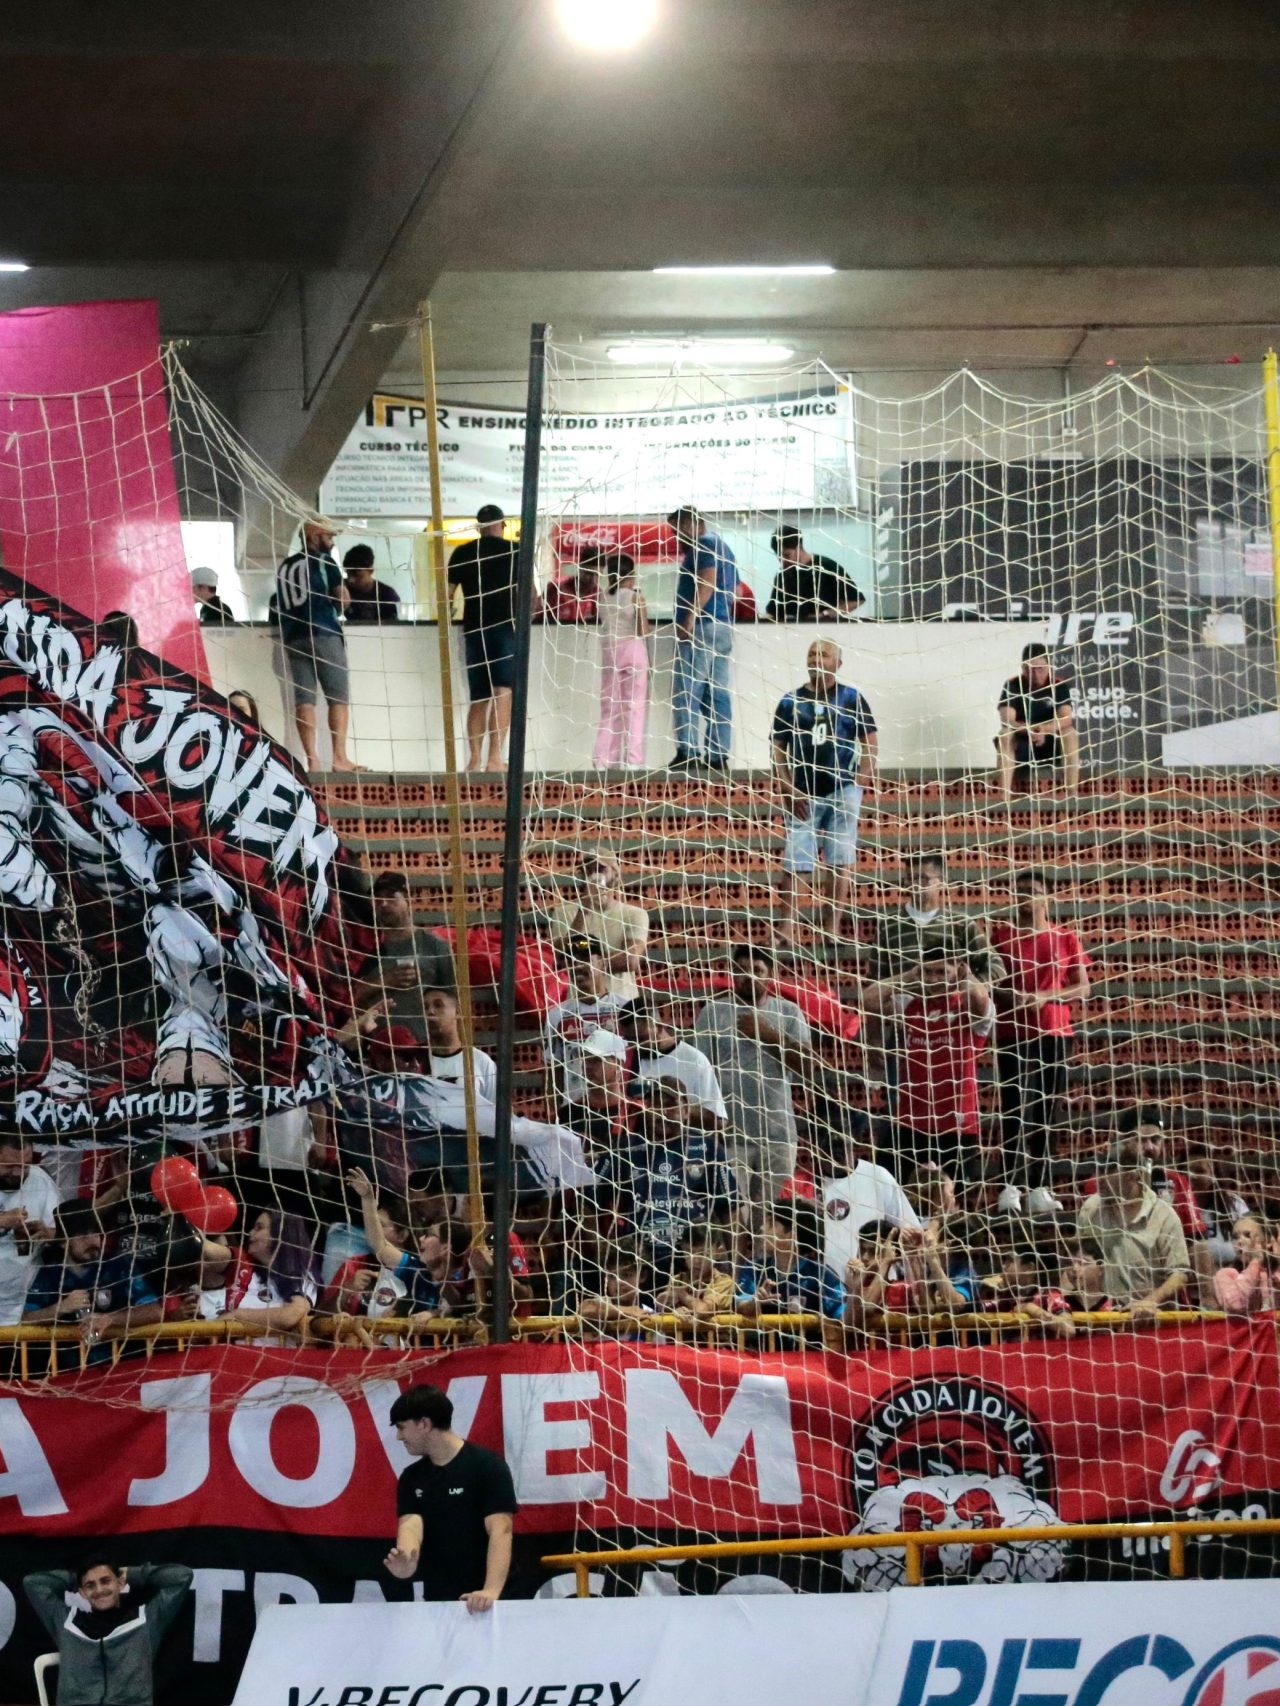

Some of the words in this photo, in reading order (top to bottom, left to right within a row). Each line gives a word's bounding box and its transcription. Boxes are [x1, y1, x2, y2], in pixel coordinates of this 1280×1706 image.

[360, 442, 401, 451] CURSO
[406, 439, 459, 452] TÉCICO
[279, 558, 309, 611] 10
[1071, 699, 1139, 719] idade.
[120, 687, 340, 923] JOVEM
[14, 1089, 99, 1134] RAÇA,
[105, 1087, 215, 1122] ATITUDE
[226, 1086, 247, 1115] E
[127, 1367, 803, 1509] JOVEM
[854, 1385, 955, 1489] TORCIDA
[964, 1388, 1044, 1479] JOVEM
